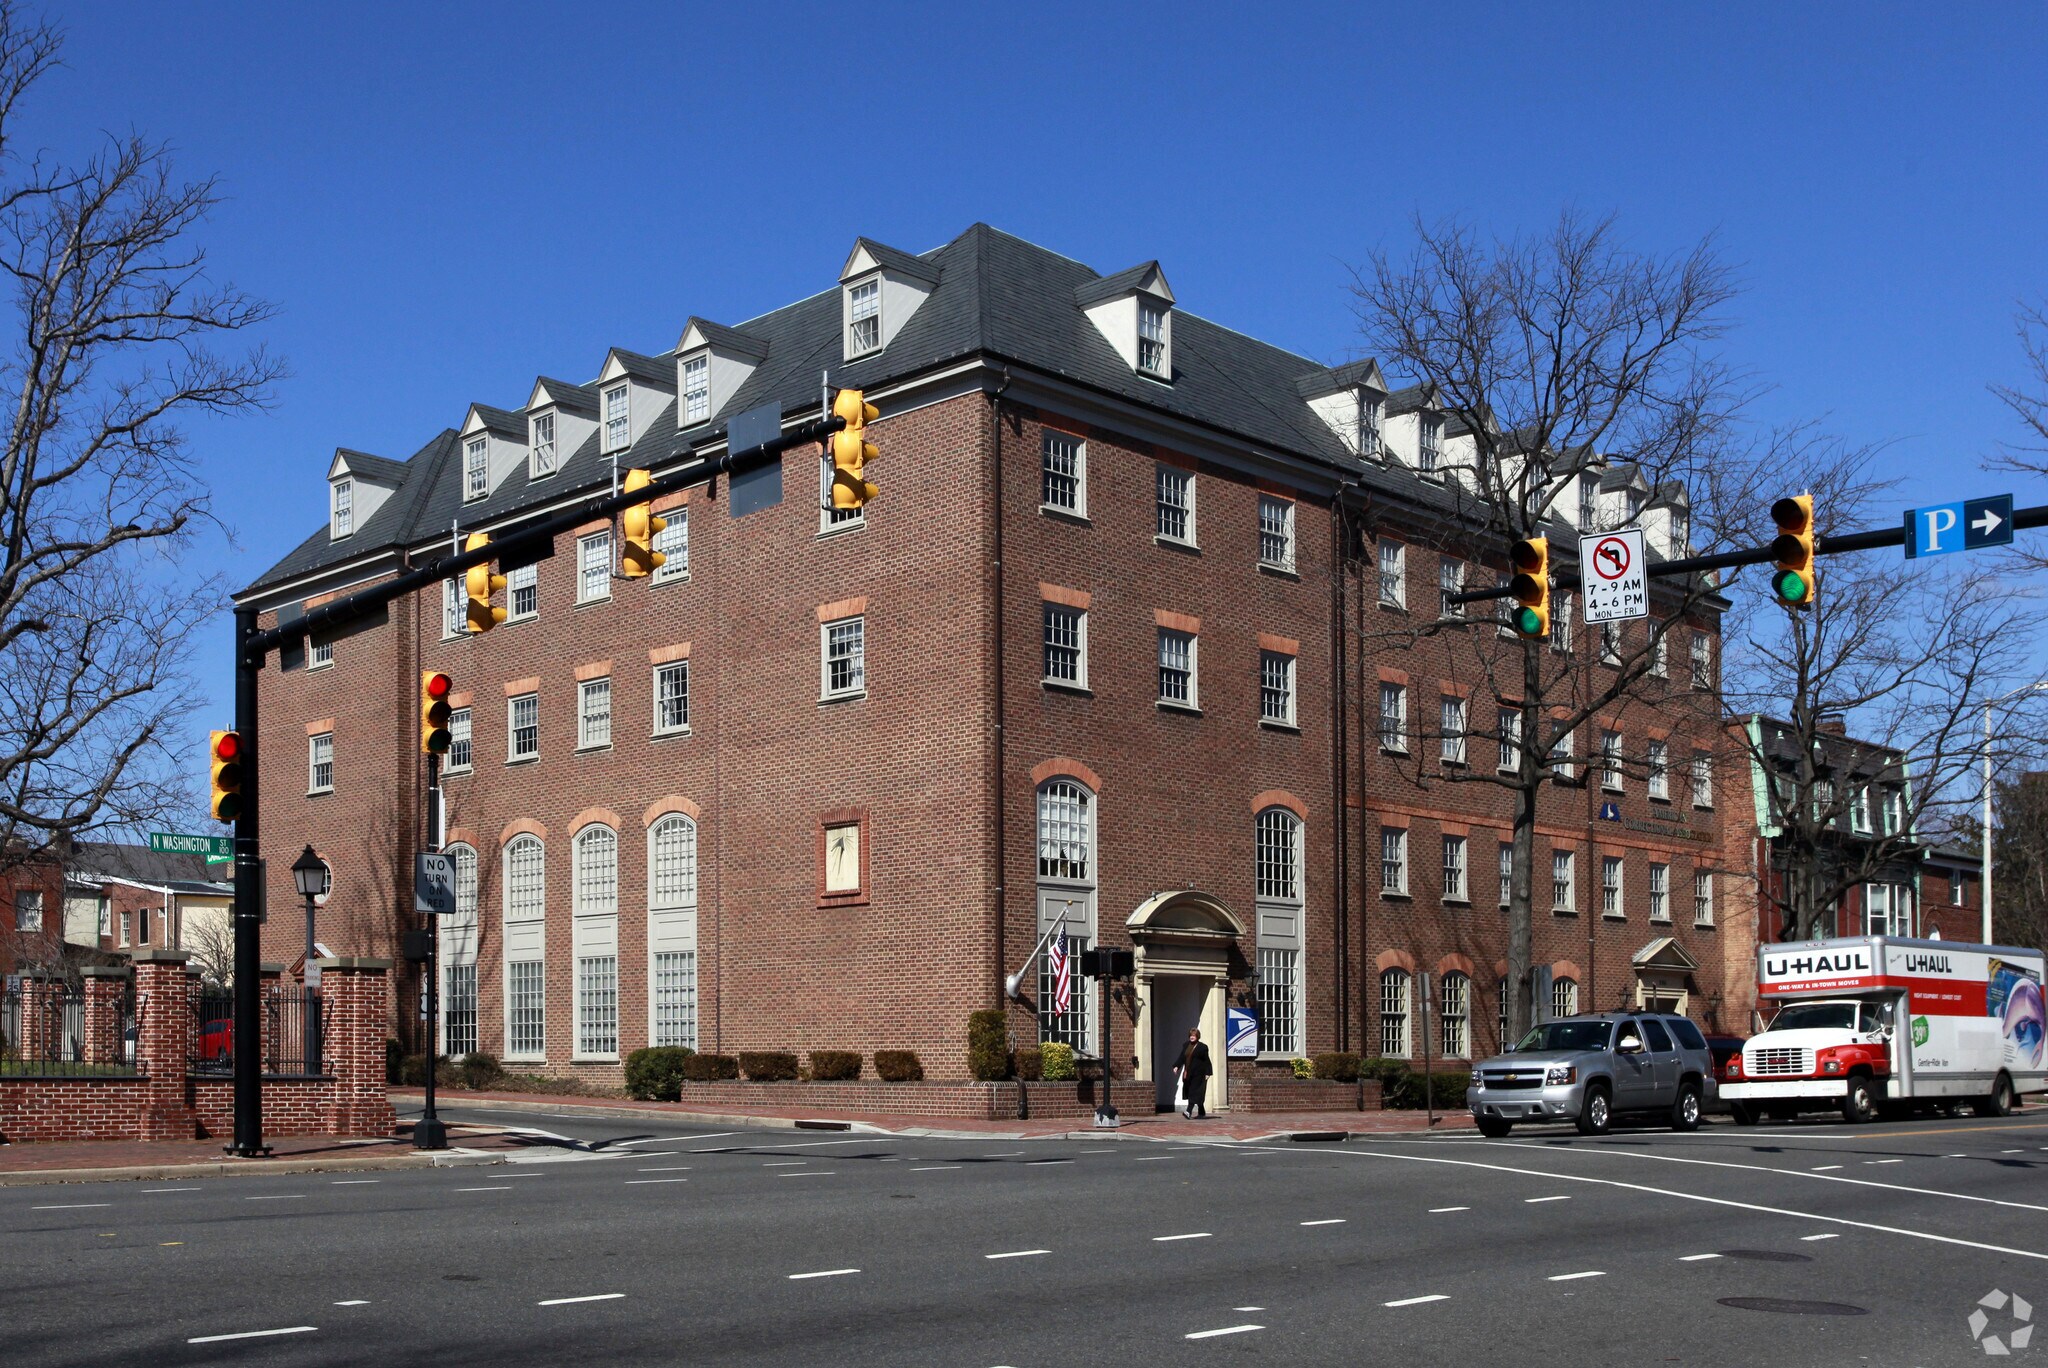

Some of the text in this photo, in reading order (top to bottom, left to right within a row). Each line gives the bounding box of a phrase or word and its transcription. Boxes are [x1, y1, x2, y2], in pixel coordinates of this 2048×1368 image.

[1924, 509, 1956, 552] P
[1588, 584, 1597, 595] 7
[1610, 581, 1618, 592] 9
[1623, 578, 1641, 592] AM
[1589, 599, 1598, 609] 4
[1611, 597, 1619, 607] 6
[1624, 593, 1642, 606] PM
[1595, 610, 1612, 619] MON
[1624, 607, 1637, 615] FRI
[153, 835, 227, 852] N WASHINGTON ST
[219, 846, 229, 854] 100
[426, 859, 445, 871] NO
[424, 873, 448, 883] TURN
[429, 885, 443, 895] ON
[426, 898, 445, 908] RED
[307, 964, 318, 972] NO
[1767, 953, 1869, 976] U-HAUL
[1906, 954, 1952, 973] U-HAUL
[1778, 983, 1804, 991] ONE-WAY
[1811, 981, 1837, 989] IN-TOWN
[1838, 979, 1859, 987] MOVES
